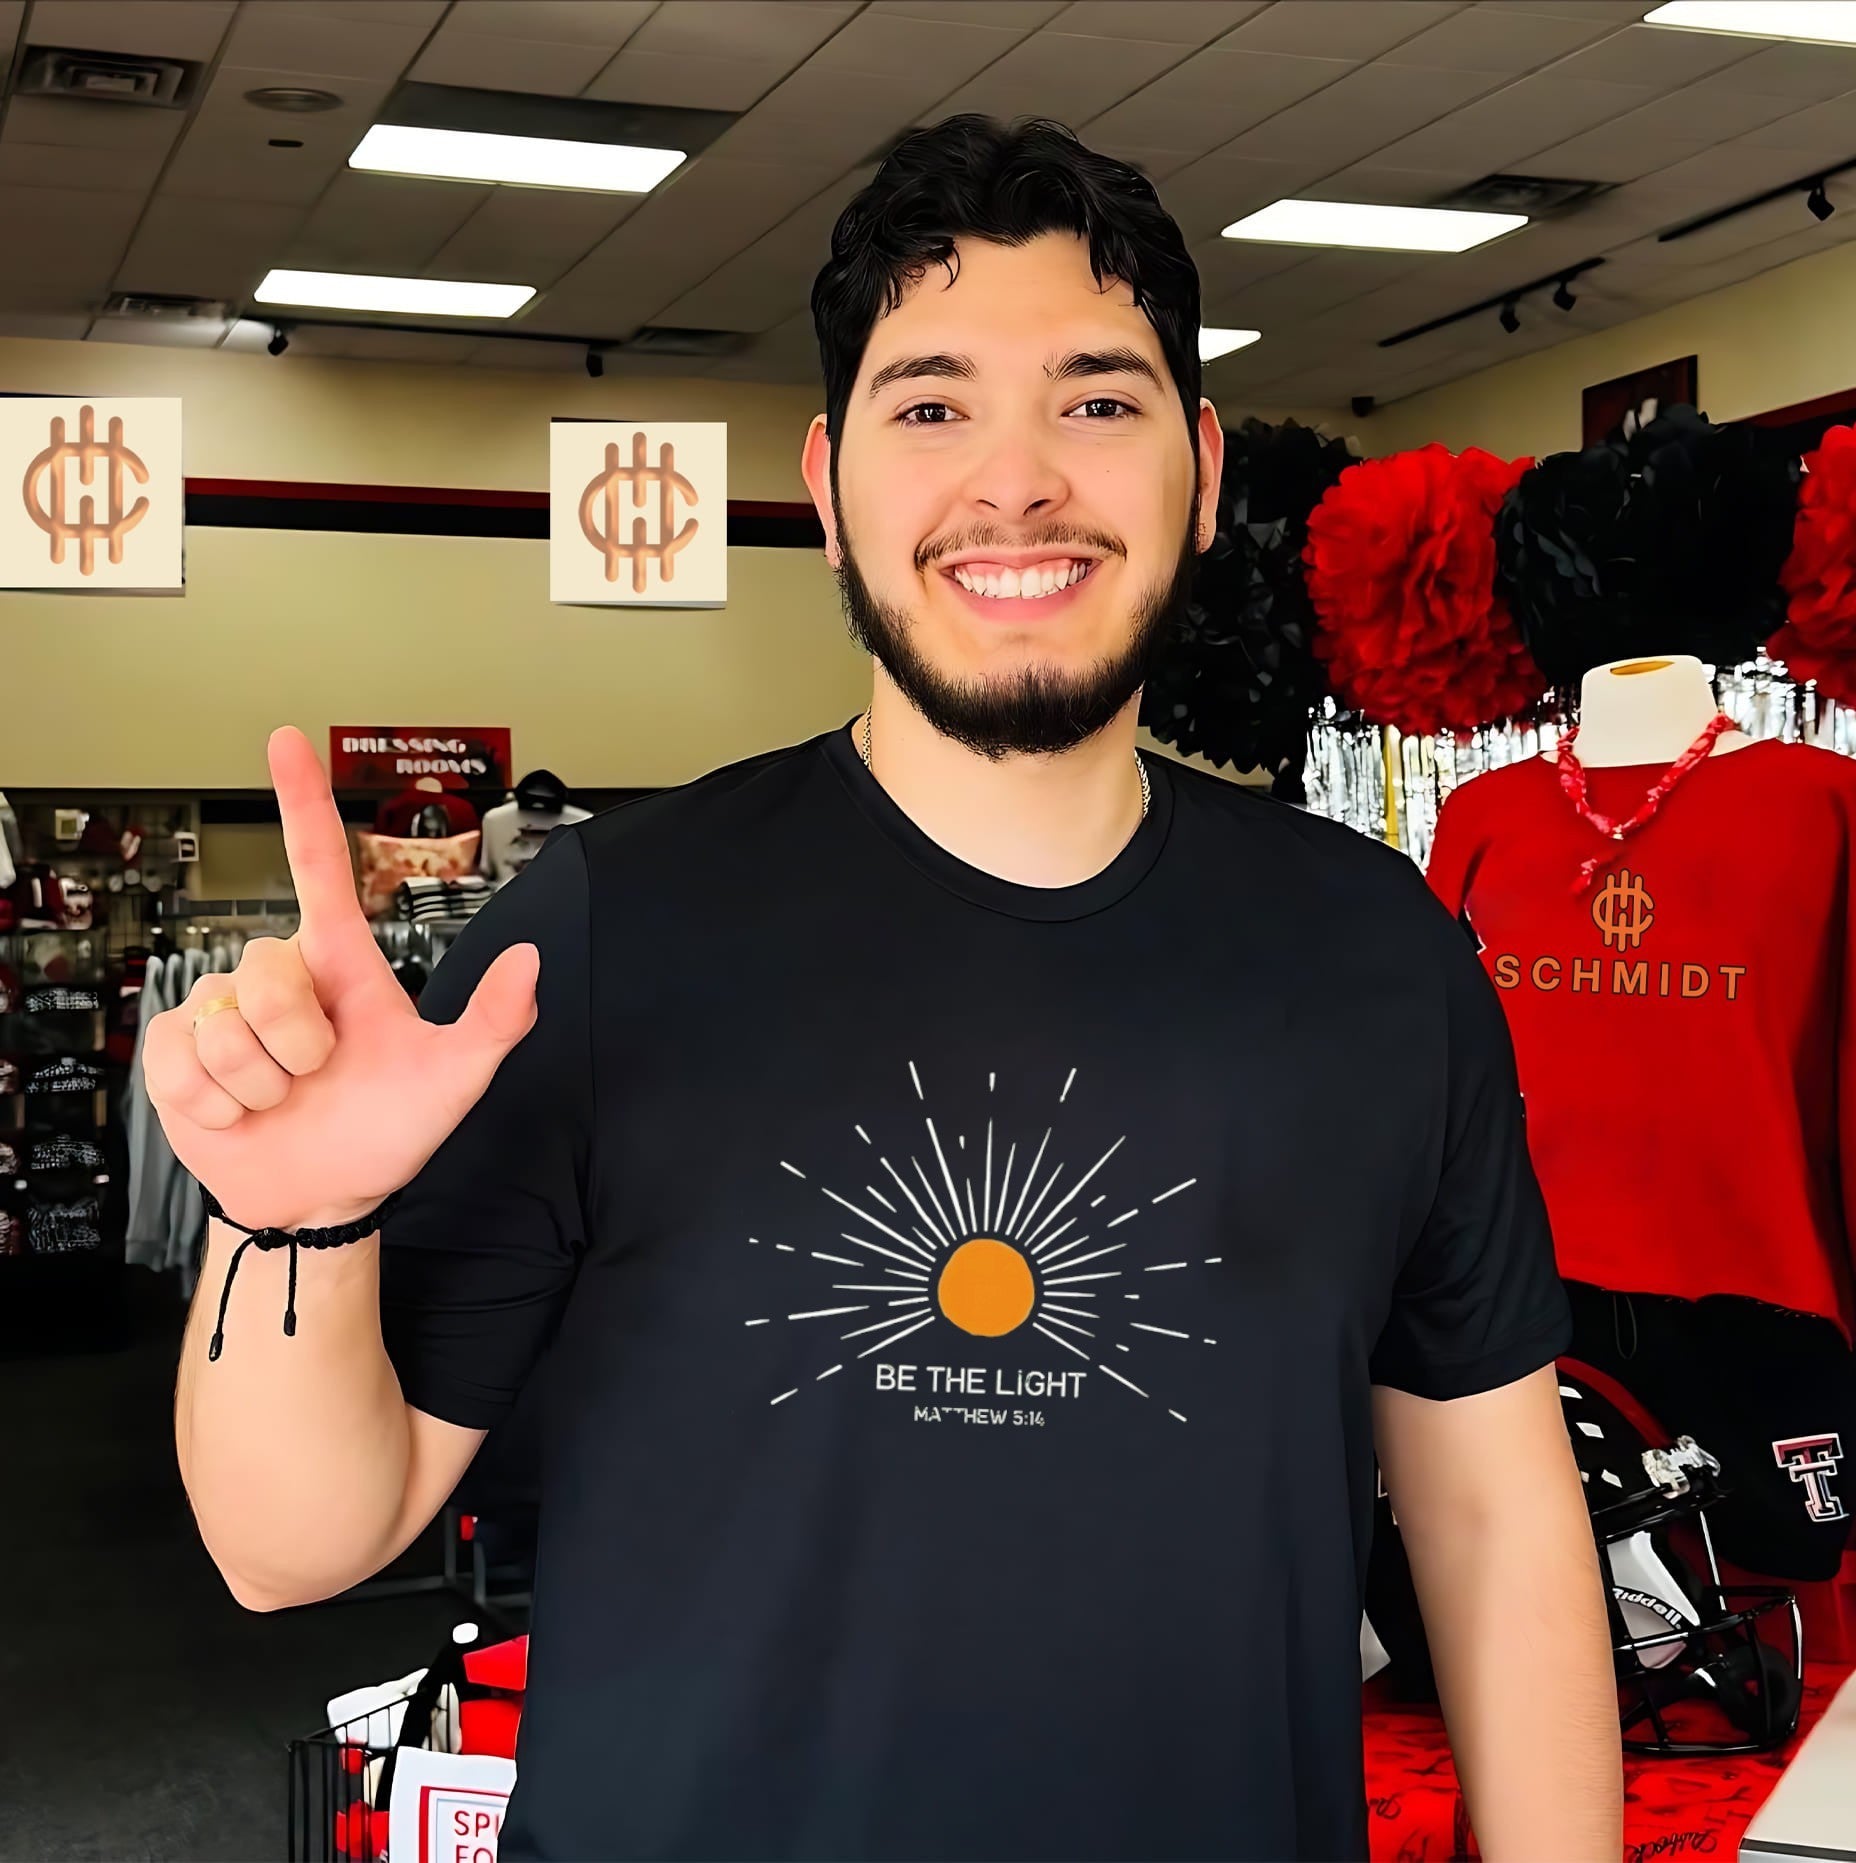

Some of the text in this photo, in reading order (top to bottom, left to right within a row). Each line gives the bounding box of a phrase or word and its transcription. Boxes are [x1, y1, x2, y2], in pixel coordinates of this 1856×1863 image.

[396, 759, 487, 775] ROOMS
[1494, 954, 1747, 1000] SCHMIDT
[876, 1364, 918, 1391] BE
[926, 1366, 987, 1394] THE
[1012, 1410, 1046, 1427] 5:14
